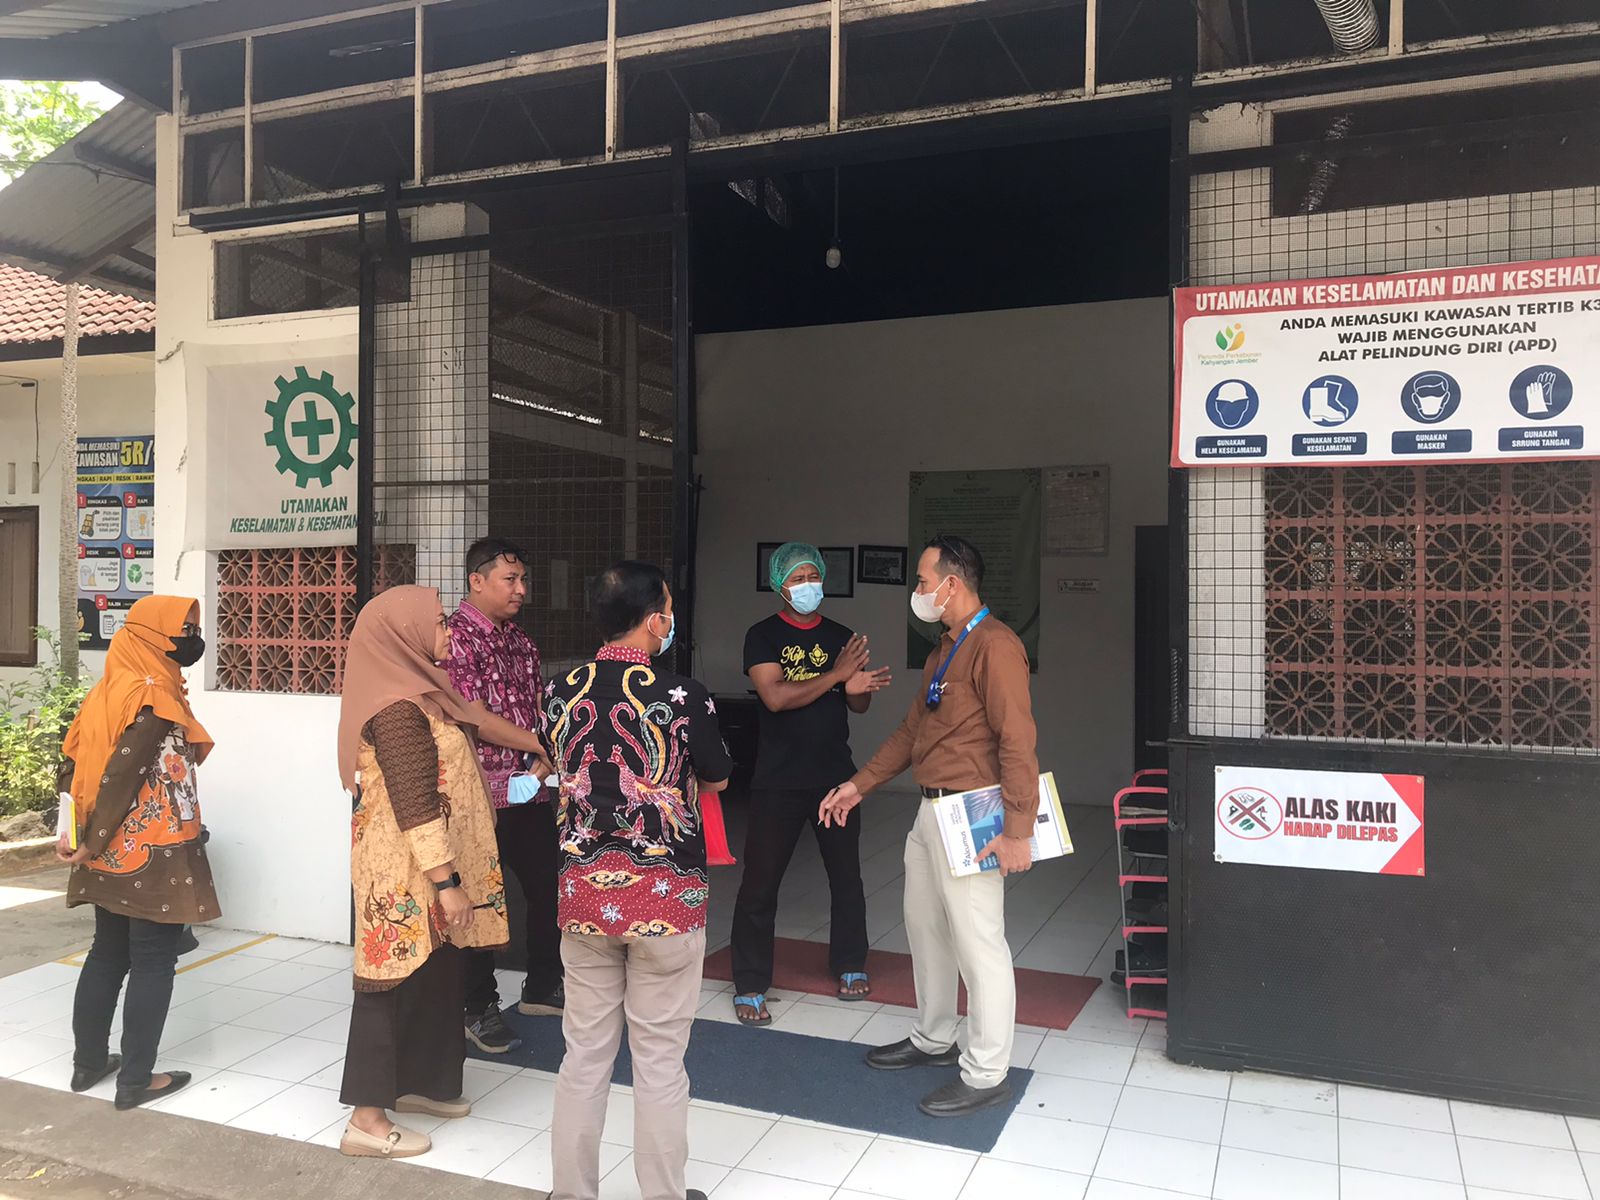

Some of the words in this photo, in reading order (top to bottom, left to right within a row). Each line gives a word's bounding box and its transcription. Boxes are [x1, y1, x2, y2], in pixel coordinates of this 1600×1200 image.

[1195, 286, 1297, 311] UTAMAKAN
[1302, 277, 1446, 305] KESELAMATAN
[1452, 273, 1496, 295] DAN
[1280, 317, 1326, 330] ANDA
[1331, 311, 1418, 327] MEMASUKI
[1425, 305, 1511, 321] KAWASAN
[1517, 301, 1574, 315] TERTIB
[1581, 299, 1600, 311] K3
[1337, 330, 1387, 344] WAJIB
[1392, 321, 1537, 341] MENGGUNAKAN
[1318, 349, 1357, 362] ALAT
[1362, 343, 1462, 360] PELINDUNG
[1467, 341, 1502, 354] DIRI
[1508, 338, 1557, 355] (APD)
[1415, 433, 1448, 442] GUNAKAN
[1523, 430, 1558, 439] GUNAKAN
[1216, 439, 1246, 447] GUNAKAN
[1302, 437, 1332, 445] GUNAKAN
[1333, 436, 1357, 444] SEPATU
[1541, 438, 1570, 447] TANGAN
[88, 441, 120, 451] MEMASUKI
[1306, 444, 1352, 452] KESELAMATAN
[1417, 442, 1446, 450] MASKER
[121, 439, 154, 466] 5R/
[1200, 447, 1217, 455] HELM
[1218, 447, 1262, 455] KESELAMATAN
[79, 496, 83, 504] 1
[127, 495, 133, 504] 2
[280, 496, 348, 514] UTAMAKAN
[230, 517, 297, 533] KESELAMATAN
[297, 518, 305, 532] &
[126, 546, 131, 555] 4
[1285, 796, 1339, 821] ALAS
[1346, 799, 1397, 824] KAKI
[1283, 821, 1333, 839] HARAP
[1336, 824, 1399, 842] DILEPAS
